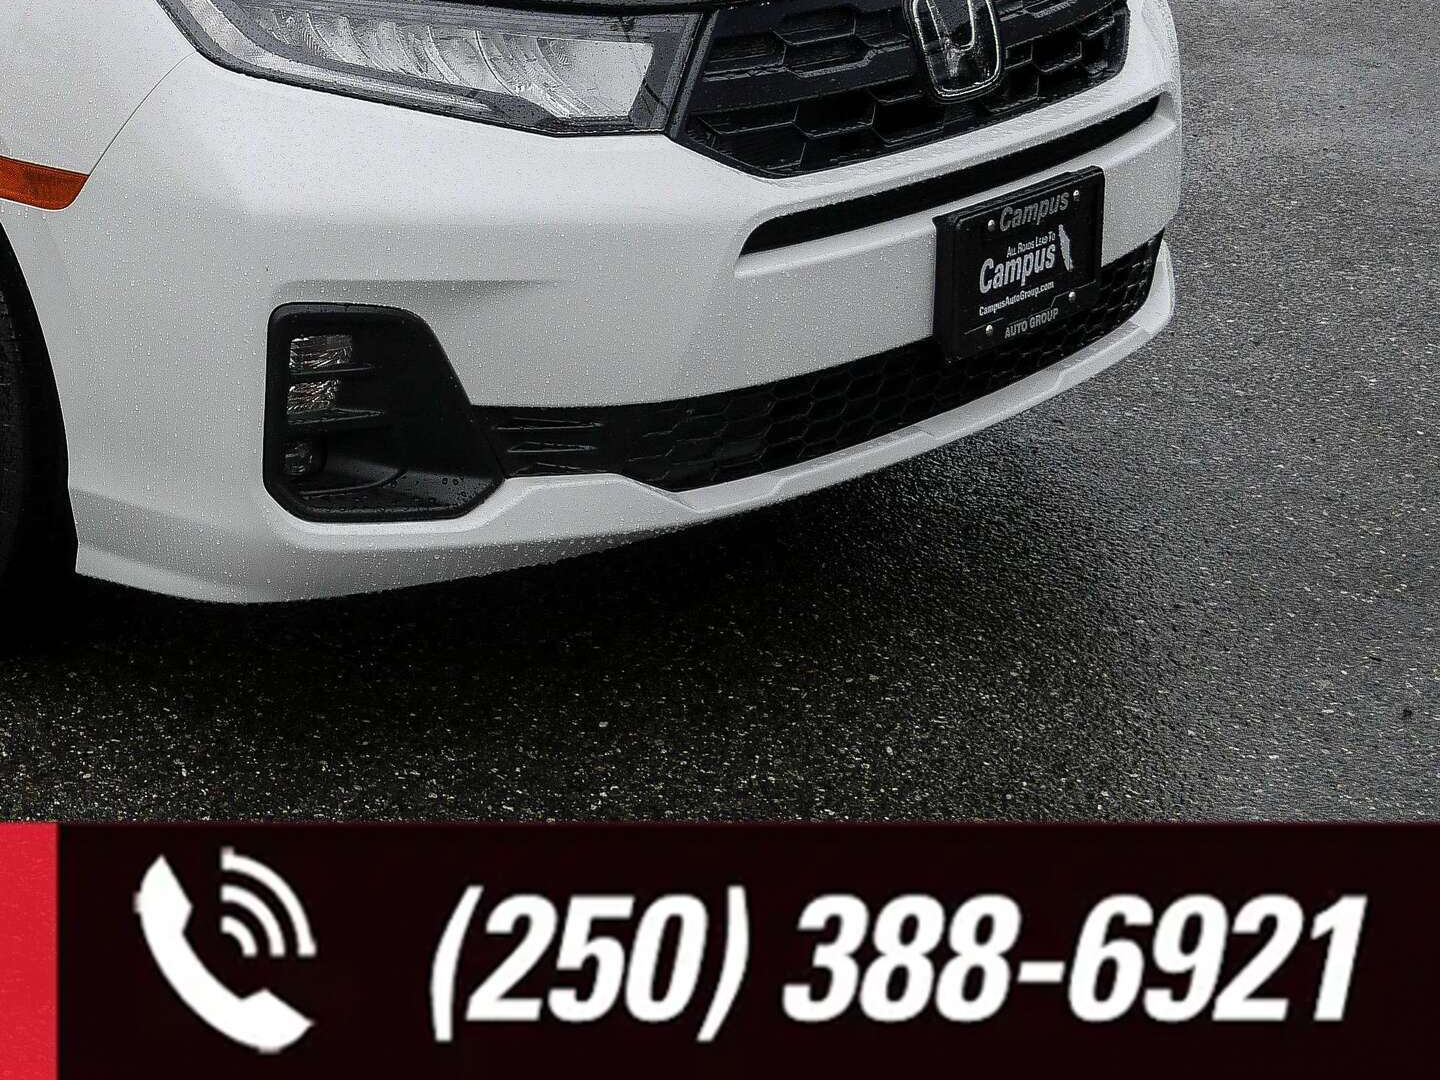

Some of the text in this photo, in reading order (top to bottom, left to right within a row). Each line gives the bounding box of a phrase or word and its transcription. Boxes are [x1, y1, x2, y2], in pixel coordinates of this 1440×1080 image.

[999, 192, 1070, 231] Campus
[979, 244, 1056, 294] Campus
[979, 281, 1055, 317] CampusAutoGroup.com
[1004, 307, 1059, 339] AUTO GROUP
